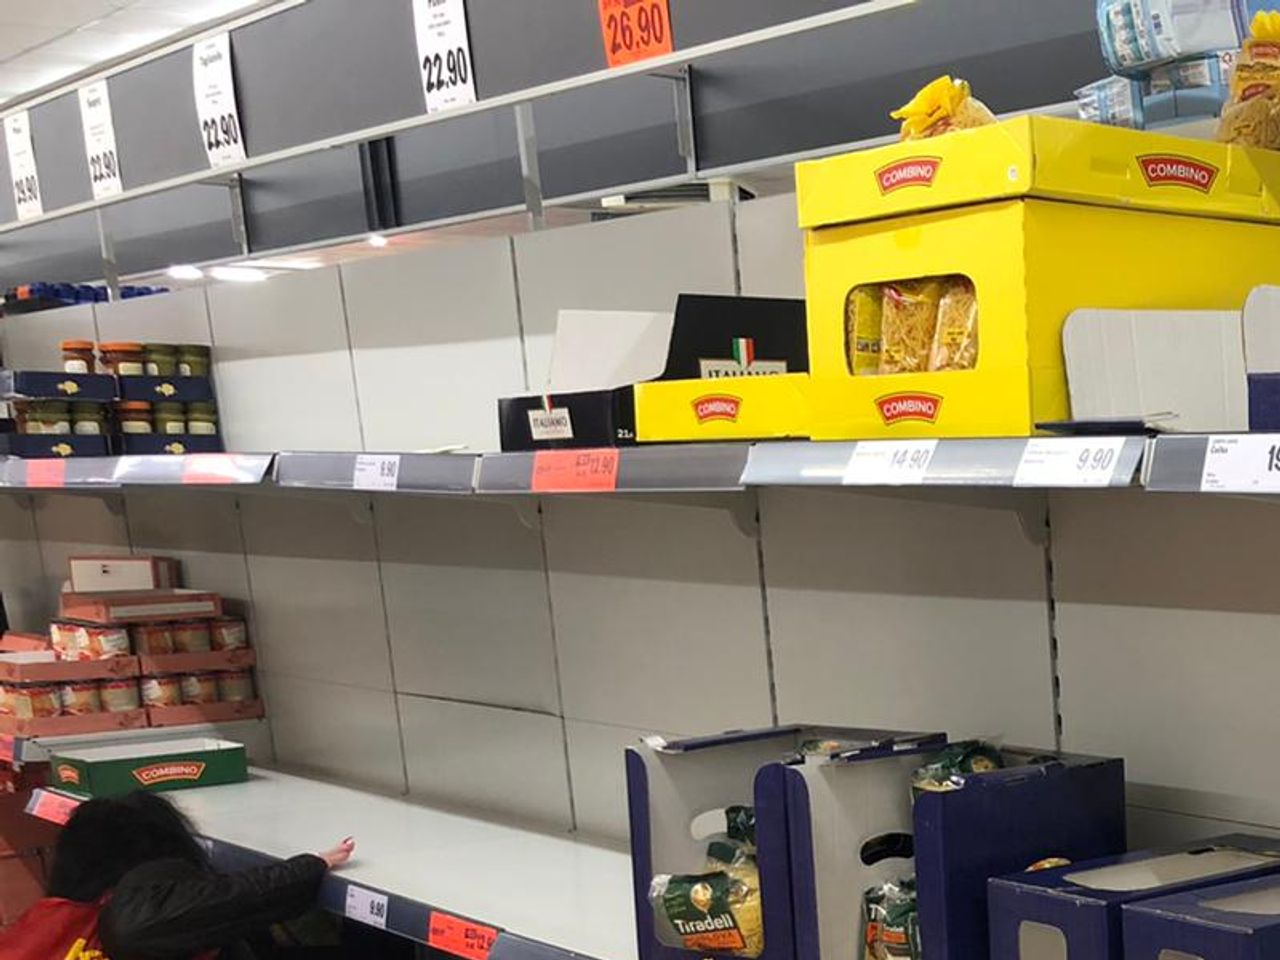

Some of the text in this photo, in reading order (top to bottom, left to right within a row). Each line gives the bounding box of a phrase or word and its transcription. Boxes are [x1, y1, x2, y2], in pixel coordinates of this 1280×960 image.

[607, 3, 664, 54] 26.90
[423, 47, 468, 93] 22.90
[203, 113, 239, 151] 22.90
[882, 165, 934, 187] COMBINO
[1147, 164, 1210, 184] COMBINO
[883, 400, 935, 417] COMBINO
[1076, 448, 1115, 470] 9.90
[674, 913, 735, 934] Tiradell
